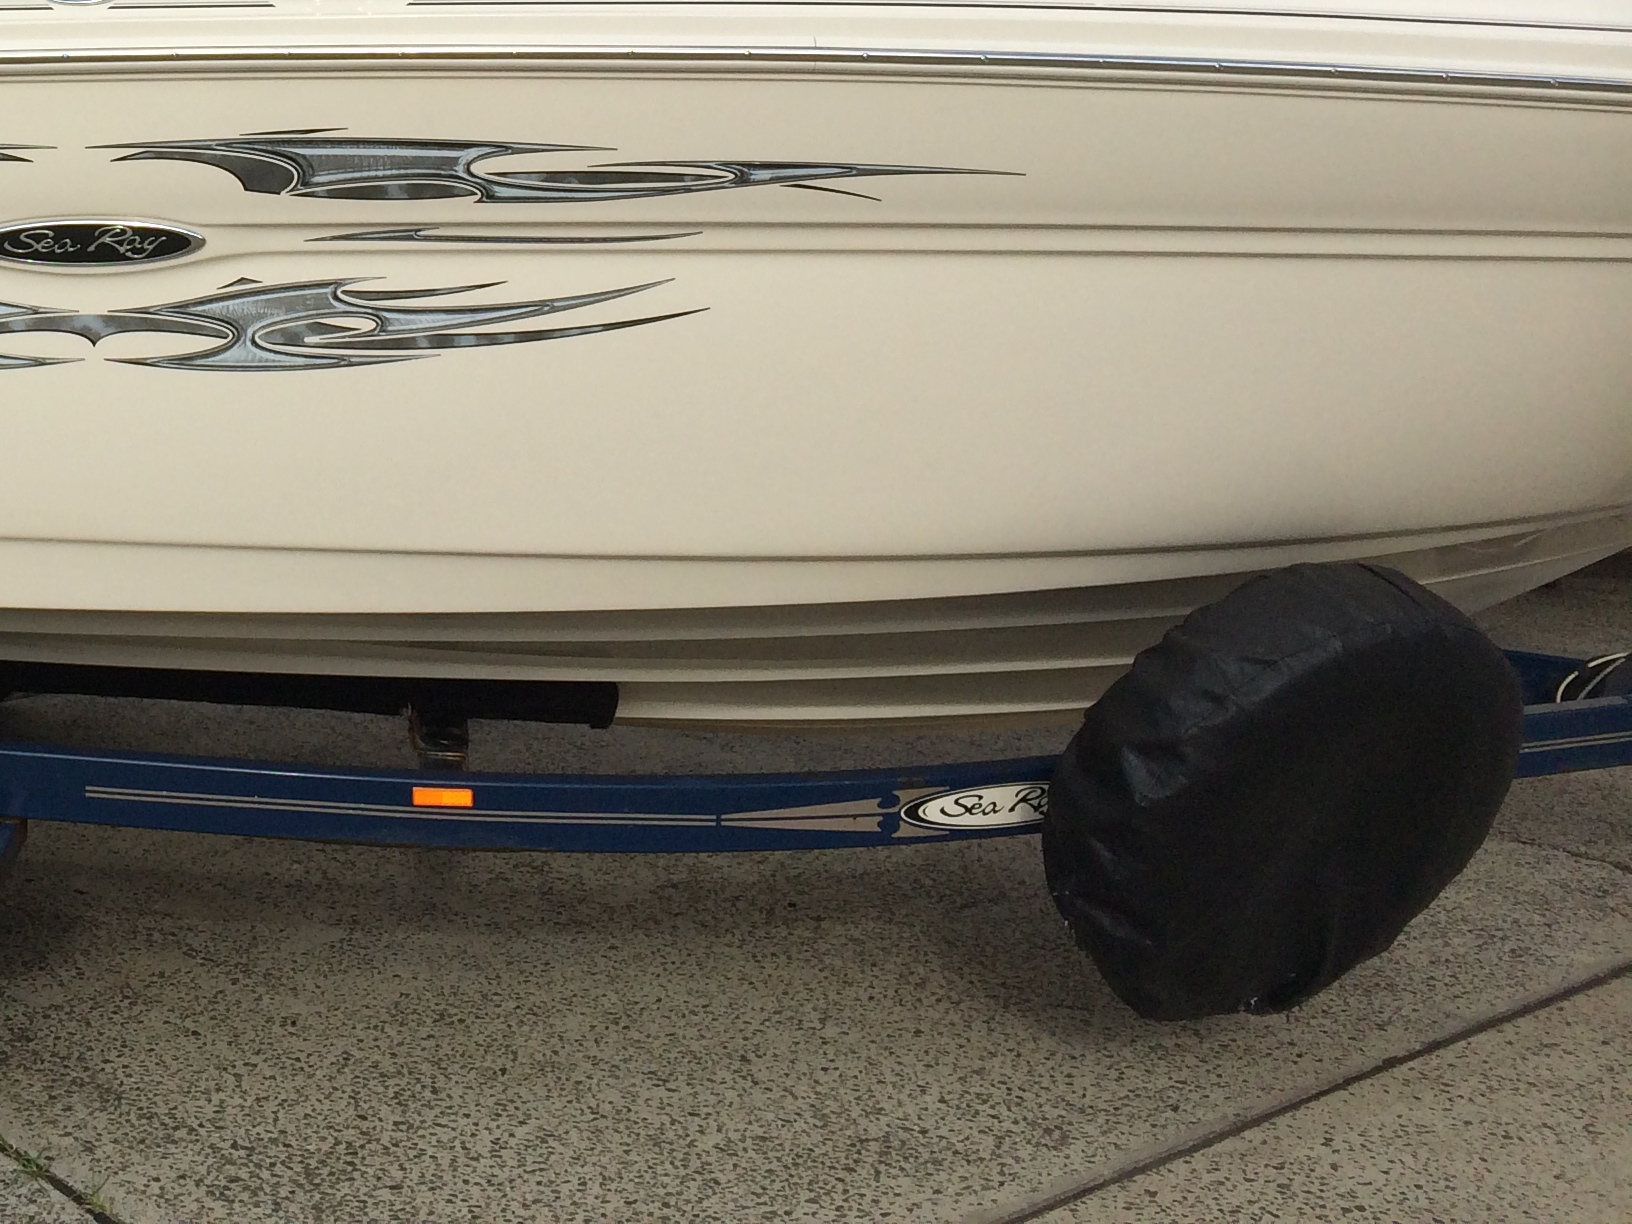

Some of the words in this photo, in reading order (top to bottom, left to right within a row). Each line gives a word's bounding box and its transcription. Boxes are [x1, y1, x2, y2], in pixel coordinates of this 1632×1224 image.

[3, 229, 81, 254] Sea
[87, 225, 168, 259] Ray
[939, 794, 1005, 818] Sea
